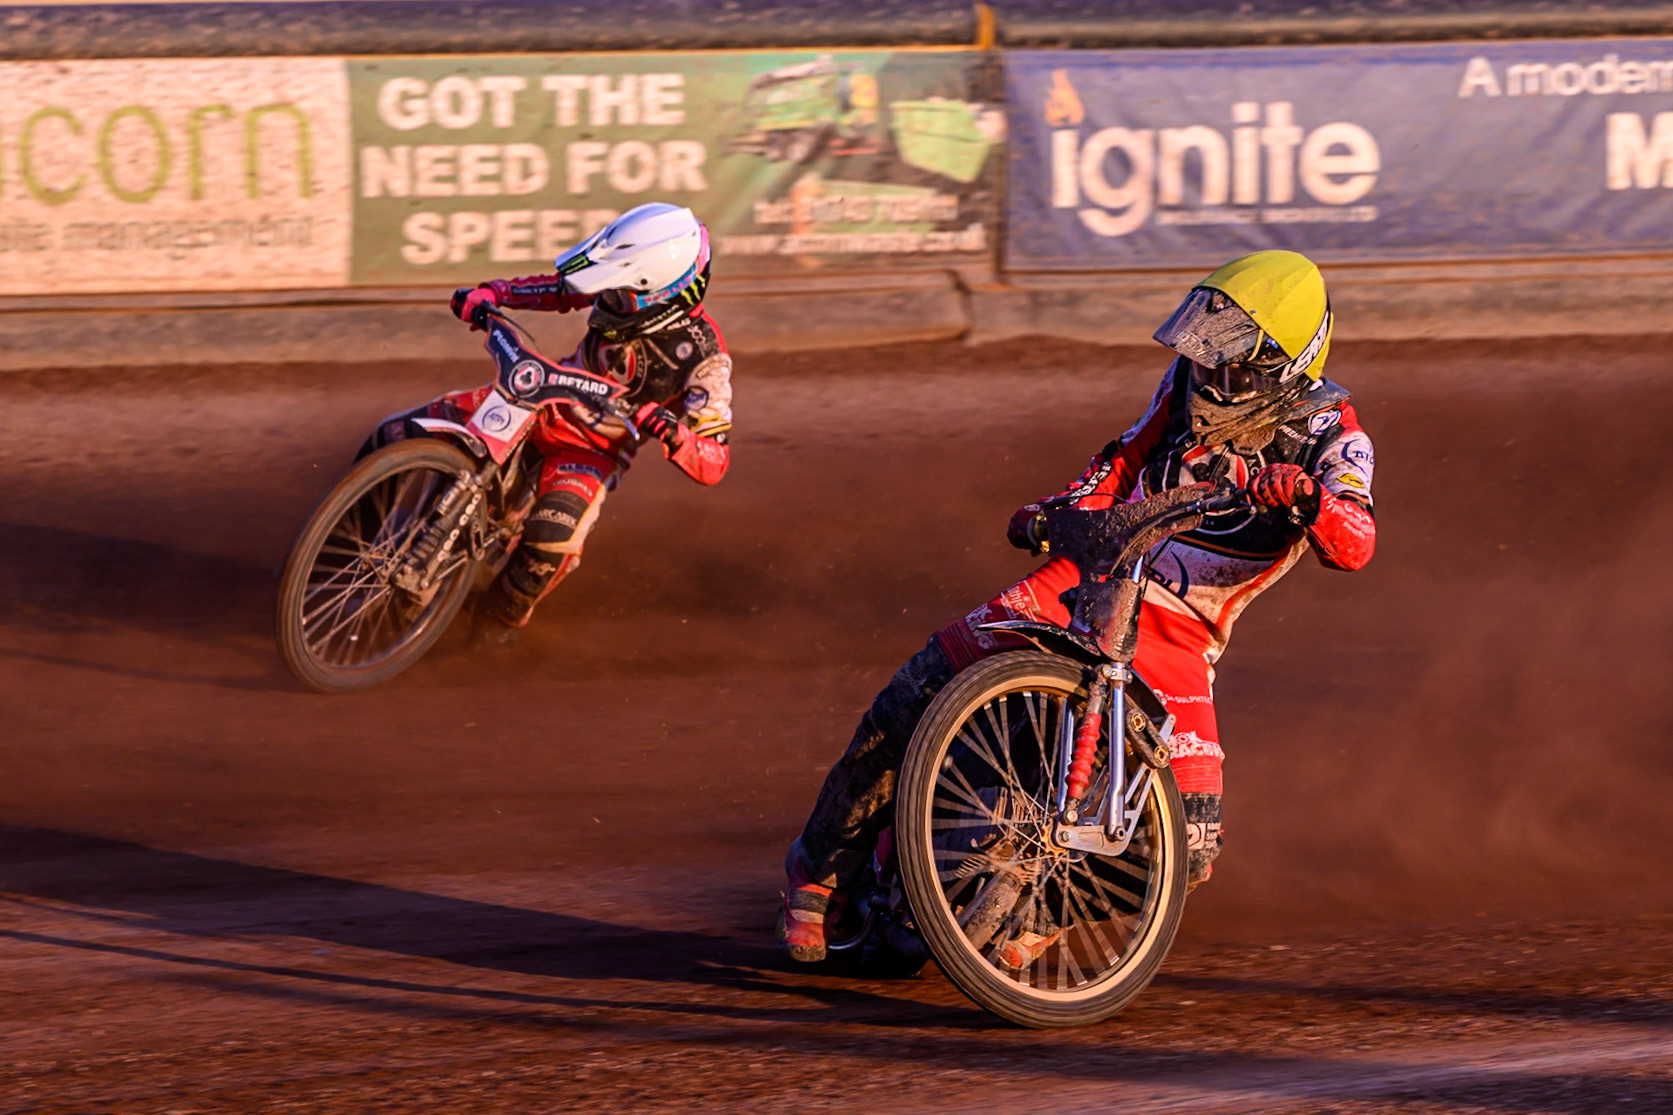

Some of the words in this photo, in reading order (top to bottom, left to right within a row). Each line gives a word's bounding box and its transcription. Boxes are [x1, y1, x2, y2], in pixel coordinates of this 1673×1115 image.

[377, 74, 528, 131] GOT
[540, 73, 687, 127] THE
[1457, 57, 1502, 98] A
[0, 103, 315, 205] corn
[360, 142, 551, 199] NEED
[565, 139, 709, 195] FOR
[1047, 98, 1382, 238] ignite
